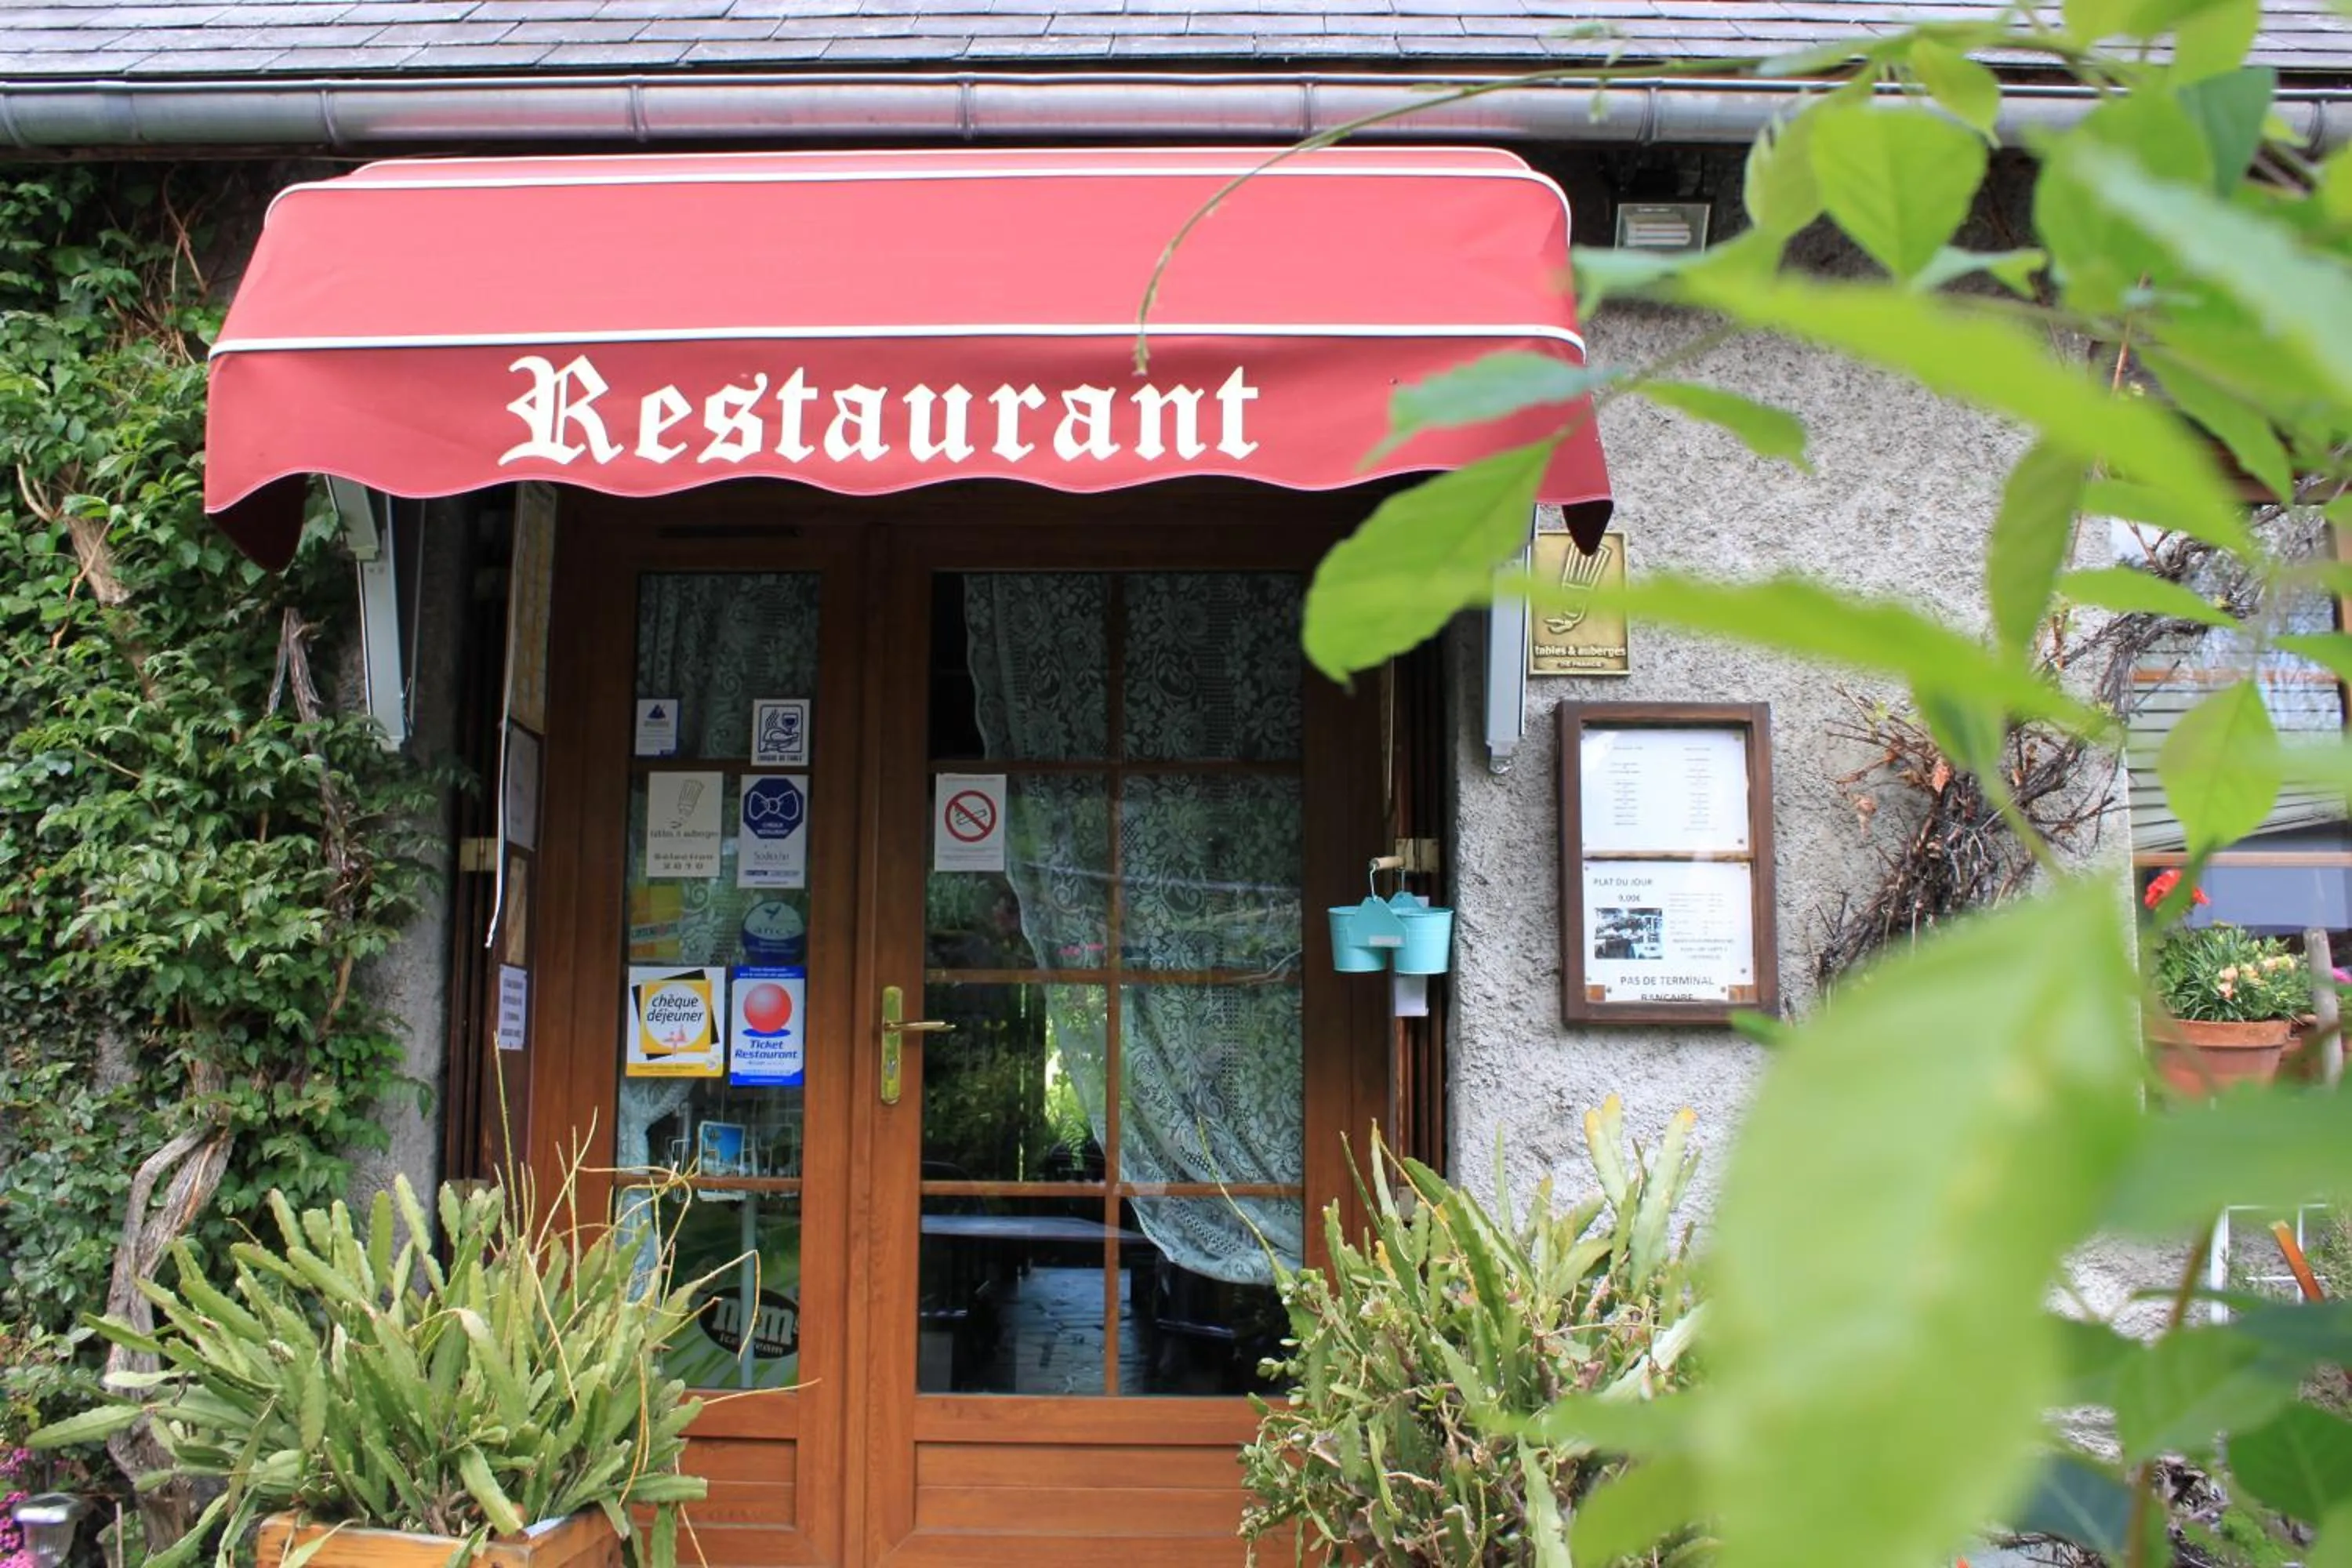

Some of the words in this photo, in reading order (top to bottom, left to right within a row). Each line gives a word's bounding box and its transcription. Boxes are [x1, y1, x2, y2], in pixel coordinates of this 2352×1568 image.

[498, 353, 1259, 466] Restaurant
[1535, 645, 1566, 656] tables
[1568, 645, 1577, 656] &
[1578, 645, 1626, 658] auberges
[1621, 977, 1640, 985] PAS
[1642, 977, 1656, 985] DE
[1660, 977, 1715, 985] TERMINAL
[652, 994, 699, 1011] chèque
[647, 1008, 703, 1024] déjeuner
[750, 1040, 783, 1048] Ticket
[735, 1049, 797, 1059] Restaurant
